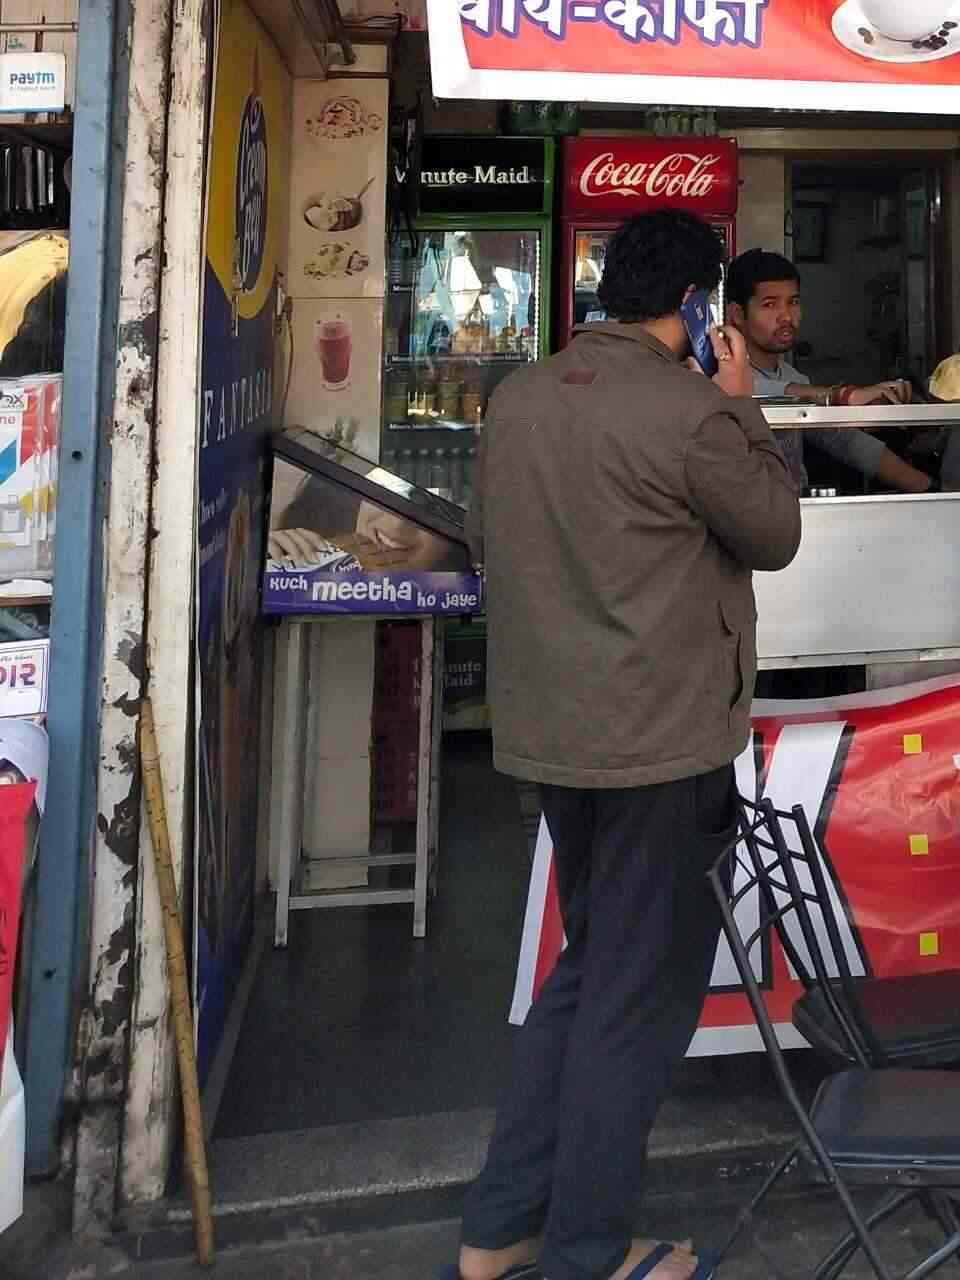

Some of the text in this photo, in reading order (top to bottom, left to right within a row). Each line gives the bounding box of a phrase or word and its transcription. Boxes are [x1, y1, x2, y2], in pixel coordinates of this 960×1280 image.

[474, 166, 530, 184] Maid
[579, 152, 721, 196] Coca-Cola
[312, 577, 412, 601] meetha
[417, 592, 436, 608] ho
[441, 593, 478, 609] jaye
